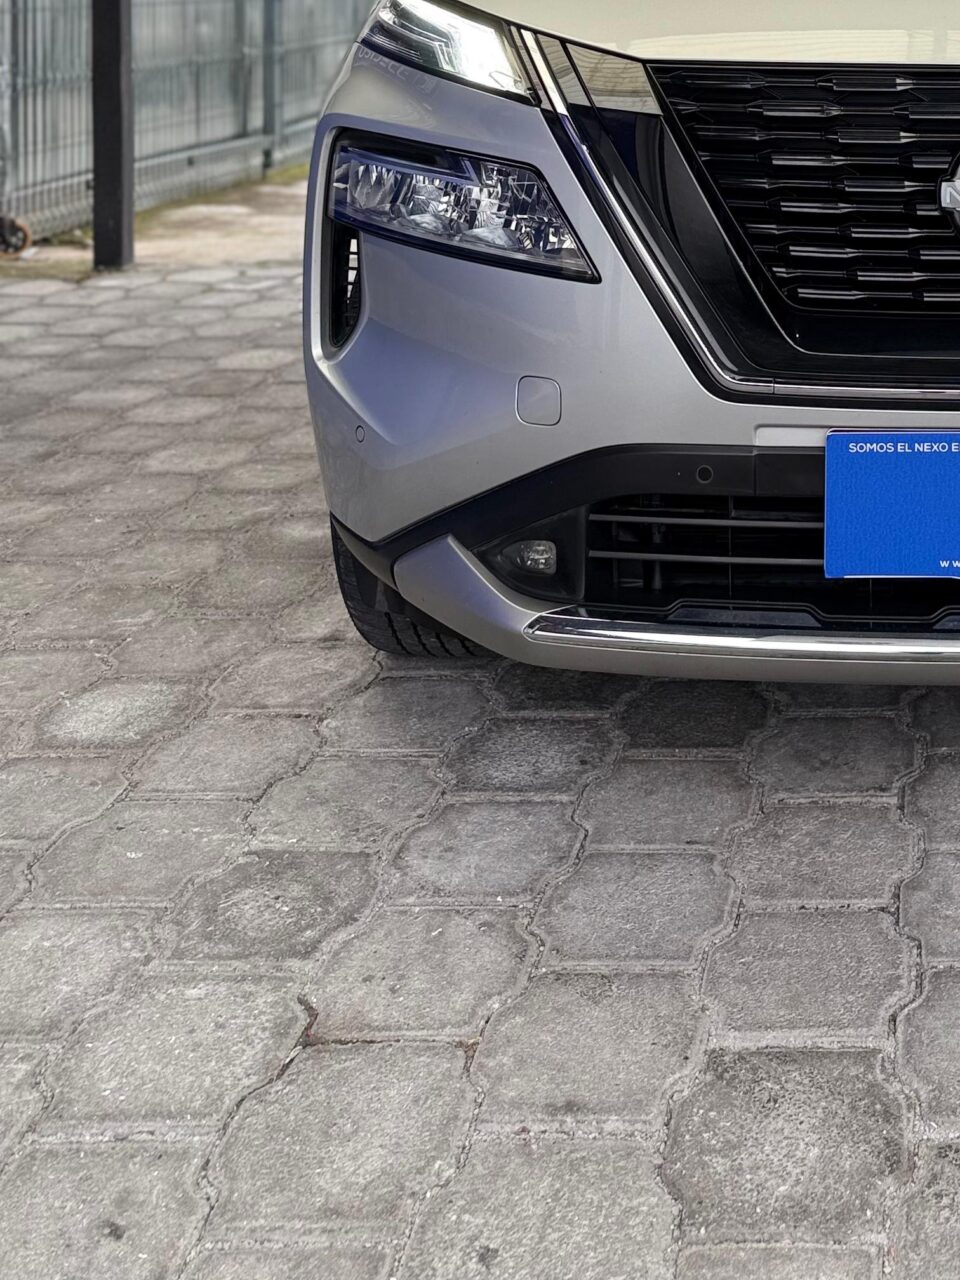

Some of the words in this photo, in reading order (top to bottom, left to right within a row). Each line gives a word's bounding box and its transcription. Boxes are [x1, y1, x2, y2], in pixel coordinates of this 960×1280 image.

[848, 442, 895, 453] SOMOS
[897, 442, 912, 453] EL
[914, 442, 949, 453] NEXO
